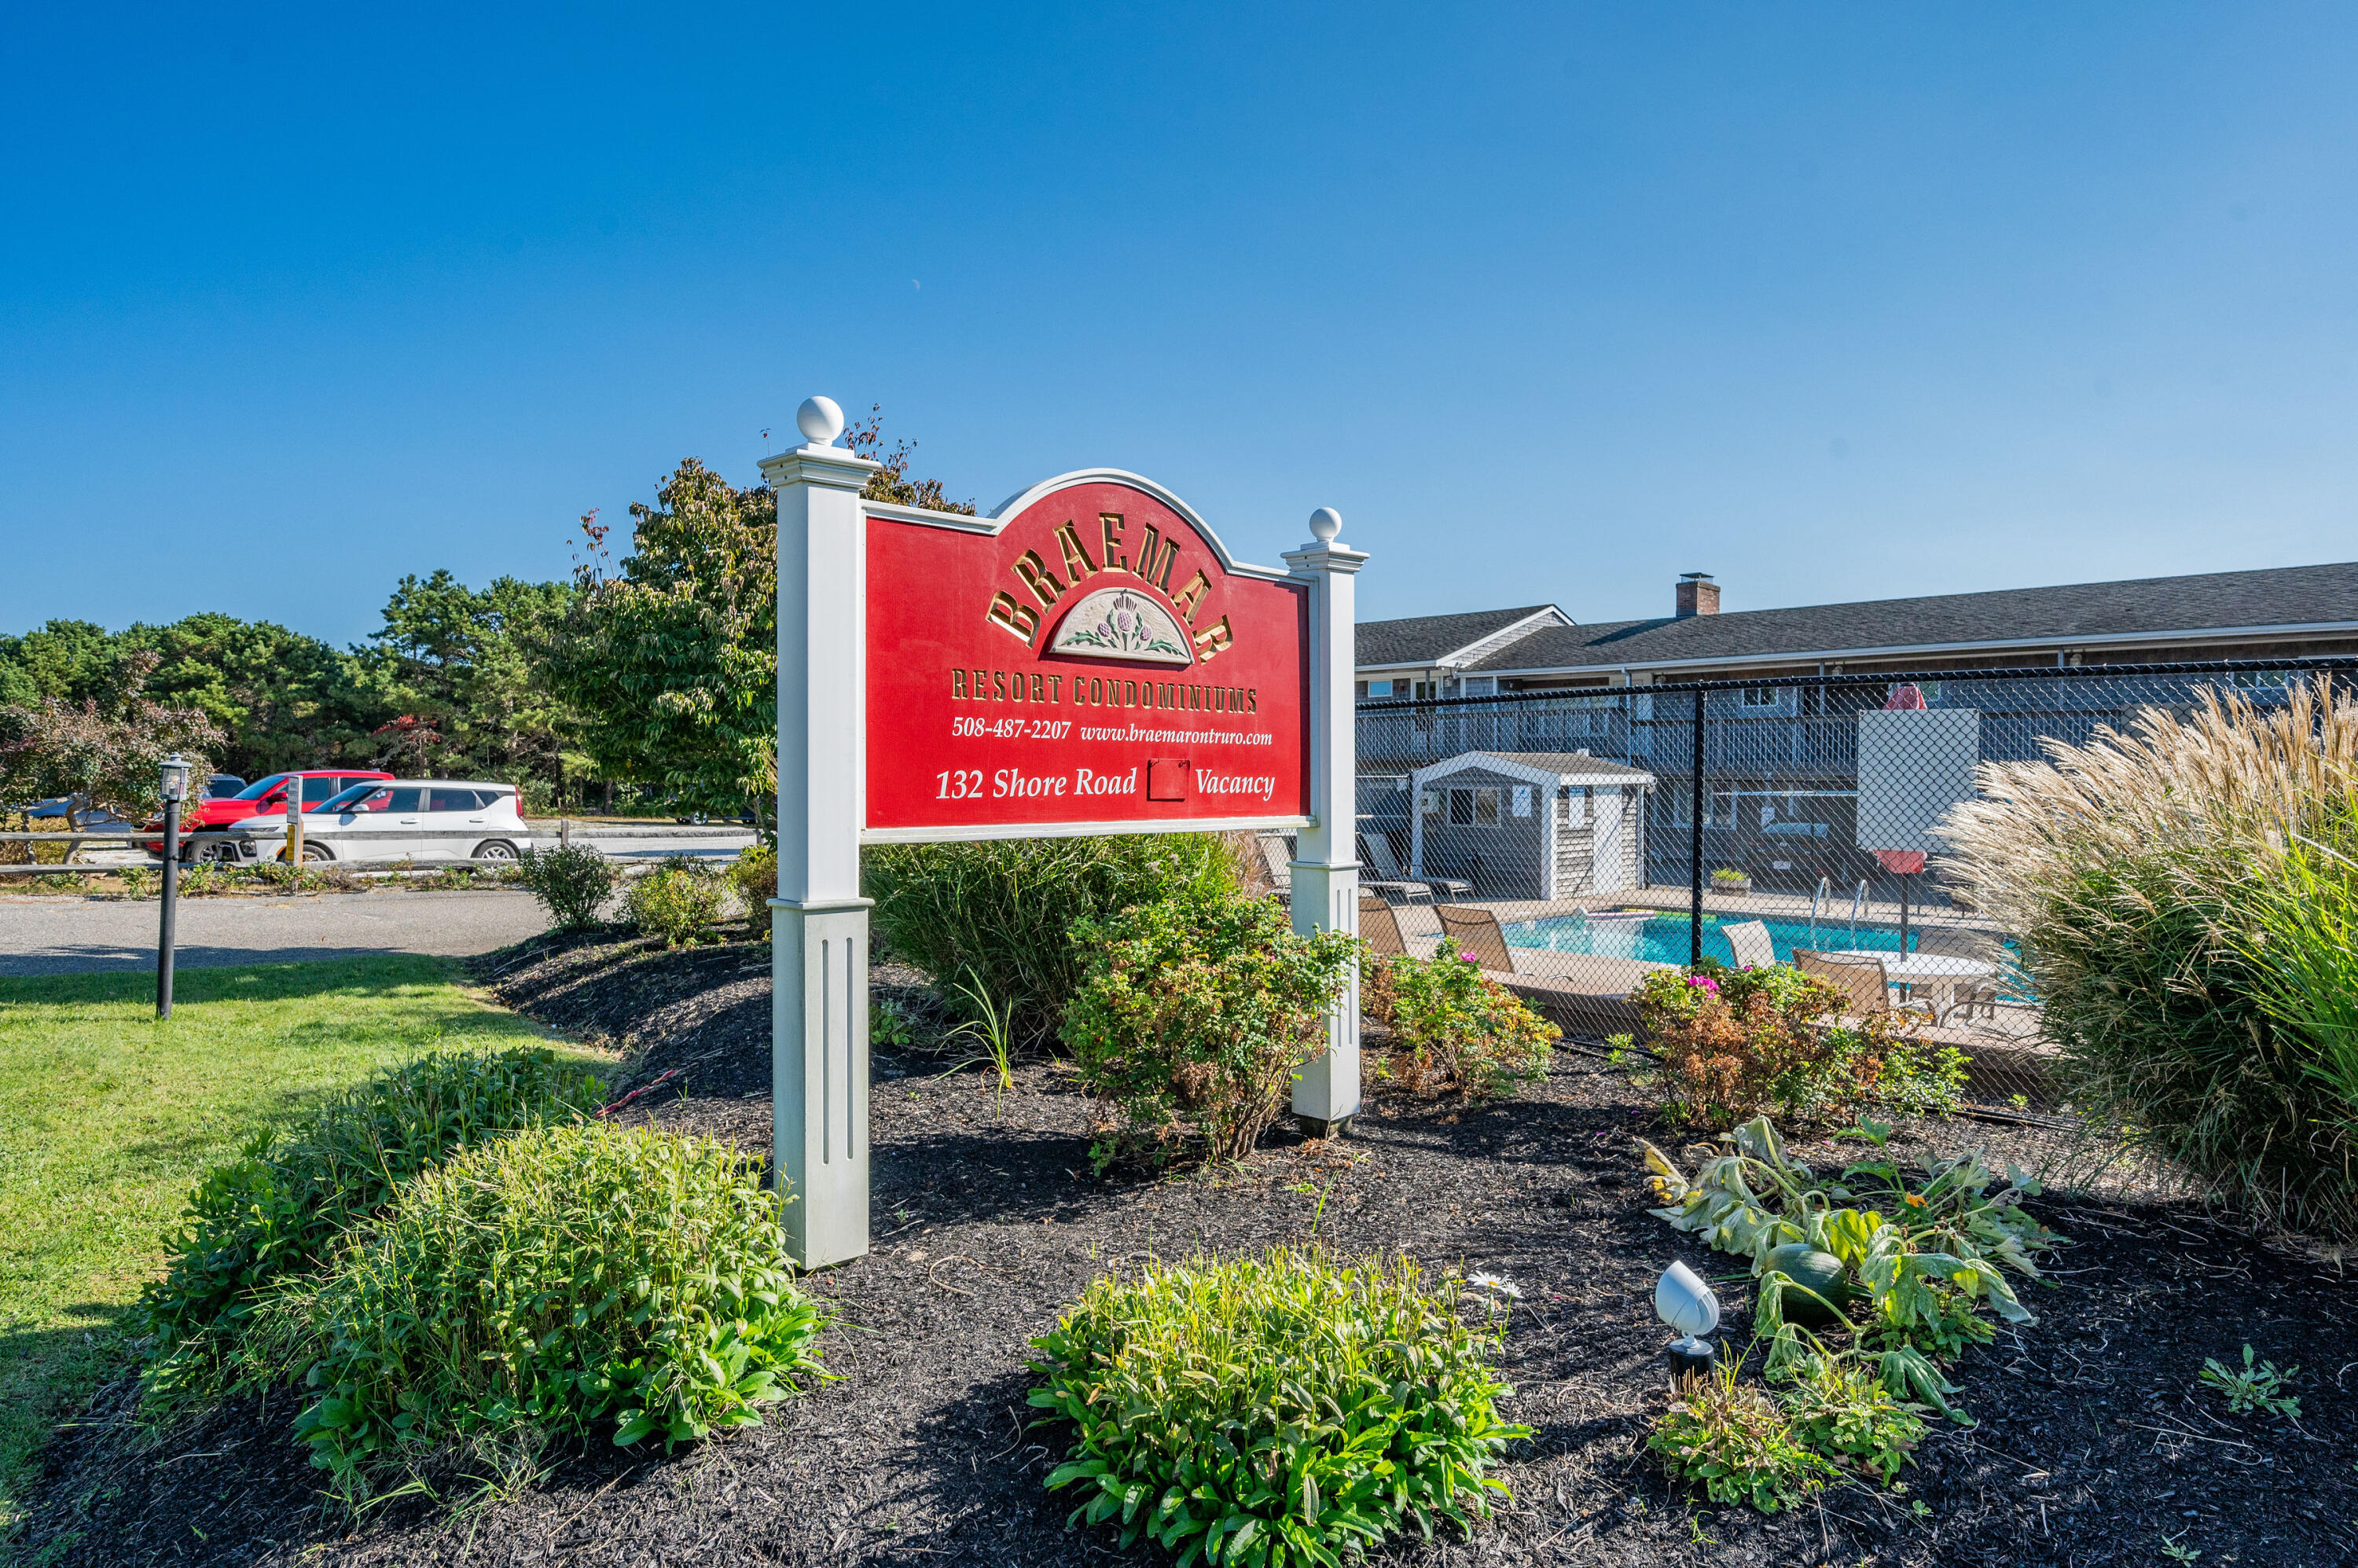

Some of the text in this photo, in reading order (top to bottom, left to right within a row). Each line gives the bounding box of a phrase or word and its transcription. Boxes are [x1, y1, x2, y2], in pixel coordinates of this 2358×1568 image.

[986, 512, 1234, 665] BRAEMAR
[952, 669, 1258, 715] RESORT CONDOMINIUMS
[953, 717, 1272, 744] 508-487-2207 www.braemarontruro.com
[935, 767, 1275, 802] 132 Shore Road Vacancy
